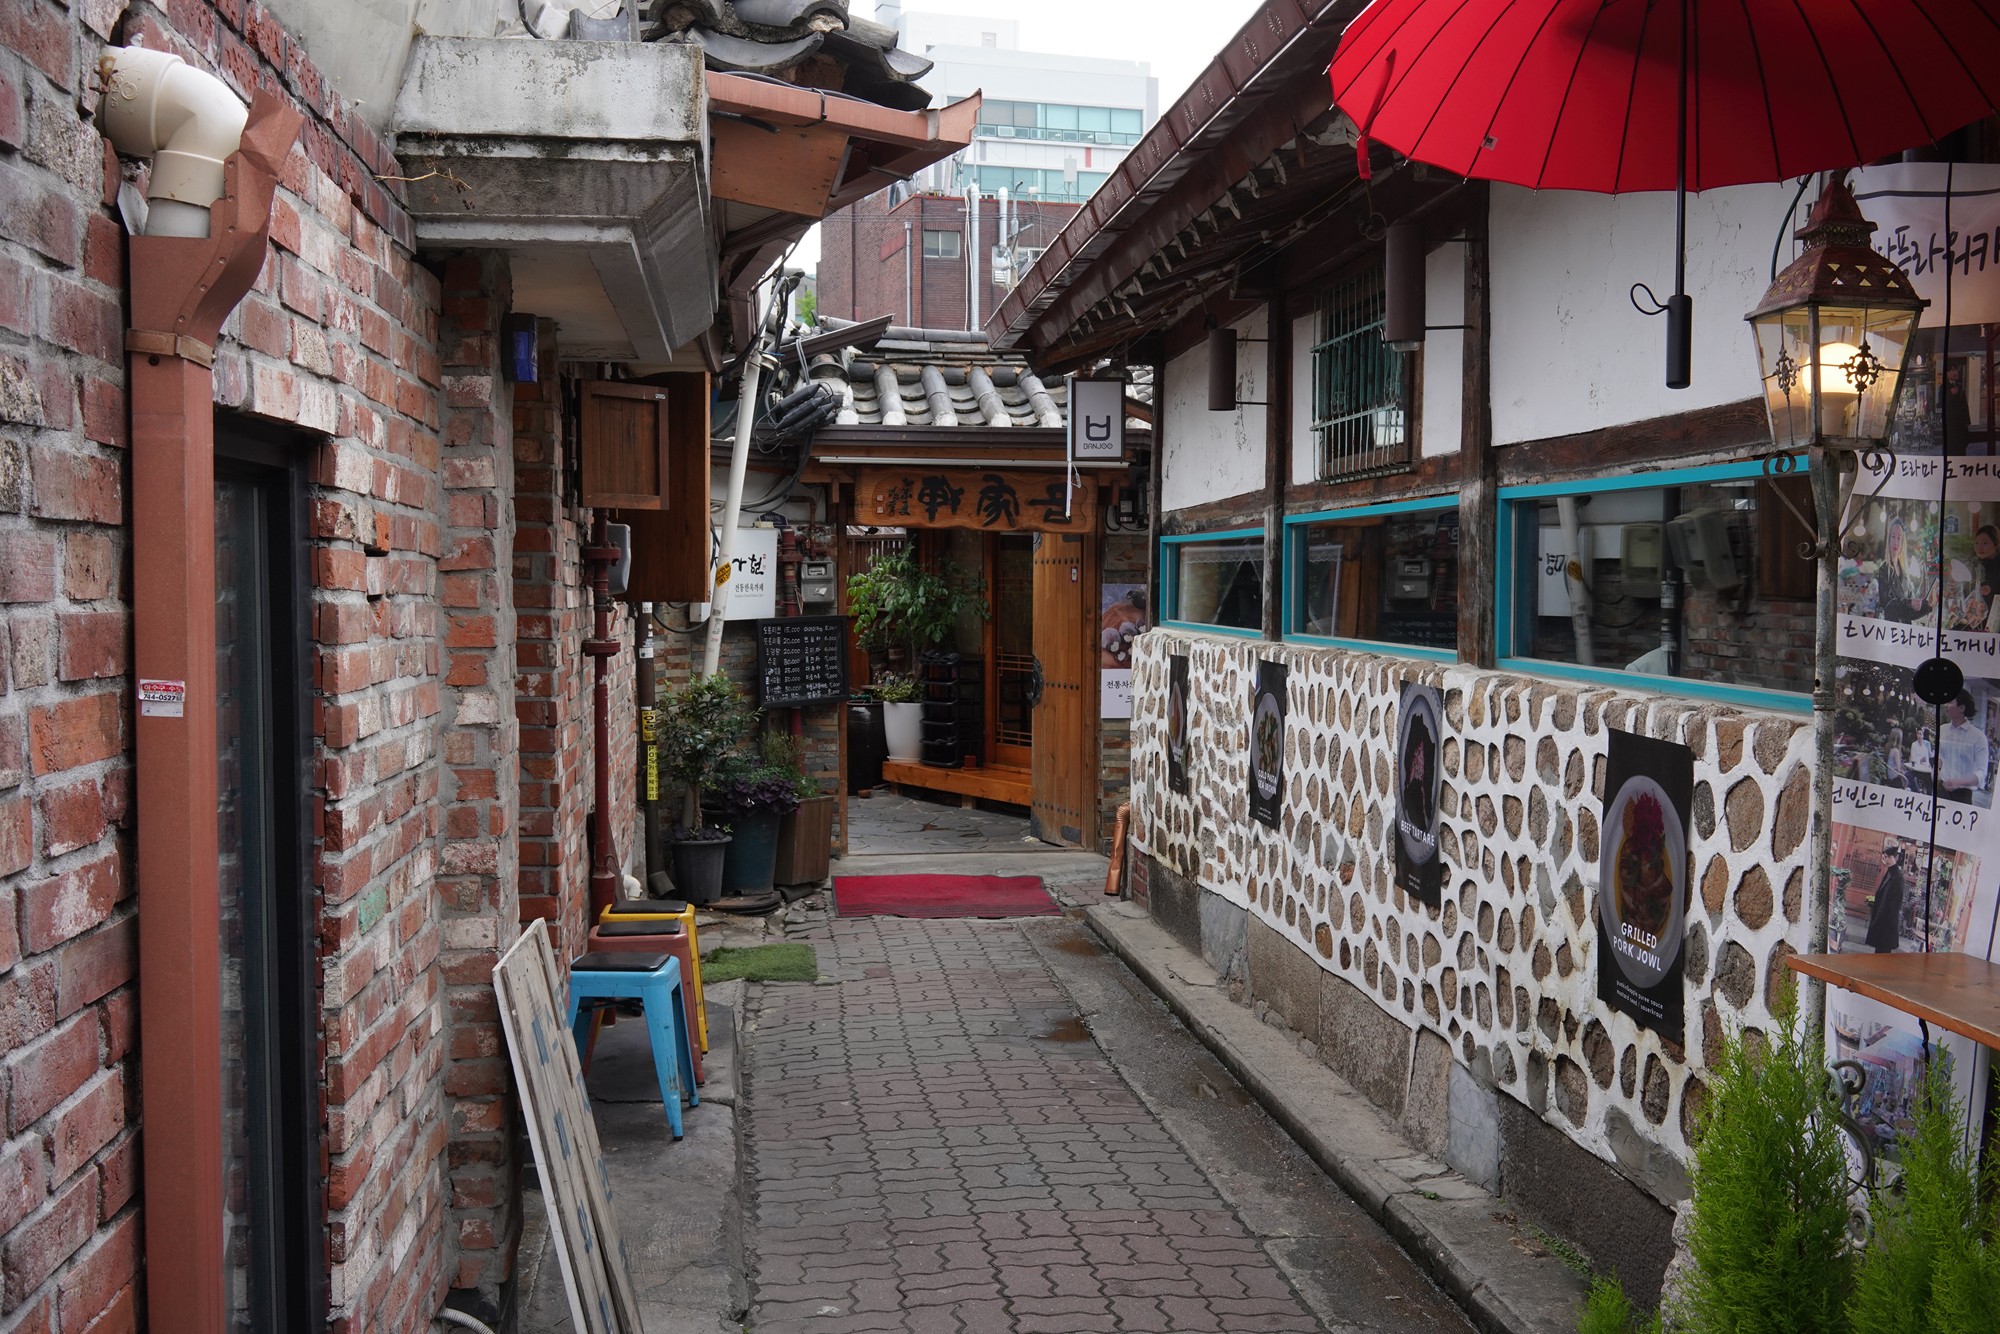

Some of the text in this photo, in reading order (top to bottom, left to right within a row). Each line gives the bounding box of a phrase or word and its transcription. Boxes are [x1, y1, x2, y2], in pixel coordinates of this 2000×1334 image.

[1083, 442, 1113, 450] BANJOO
[1901, 459, 1938, 477] 드라마
[1891, 629, 1934, 648] 드라마
[1400, 820, 1435, 847] BEEF TARTARE
[1621, 922, 1657, 949] GRILLED
[1613, 935, 1662, 972] PORK JOWL
[1650, 999, 1664, 1010] sauce
